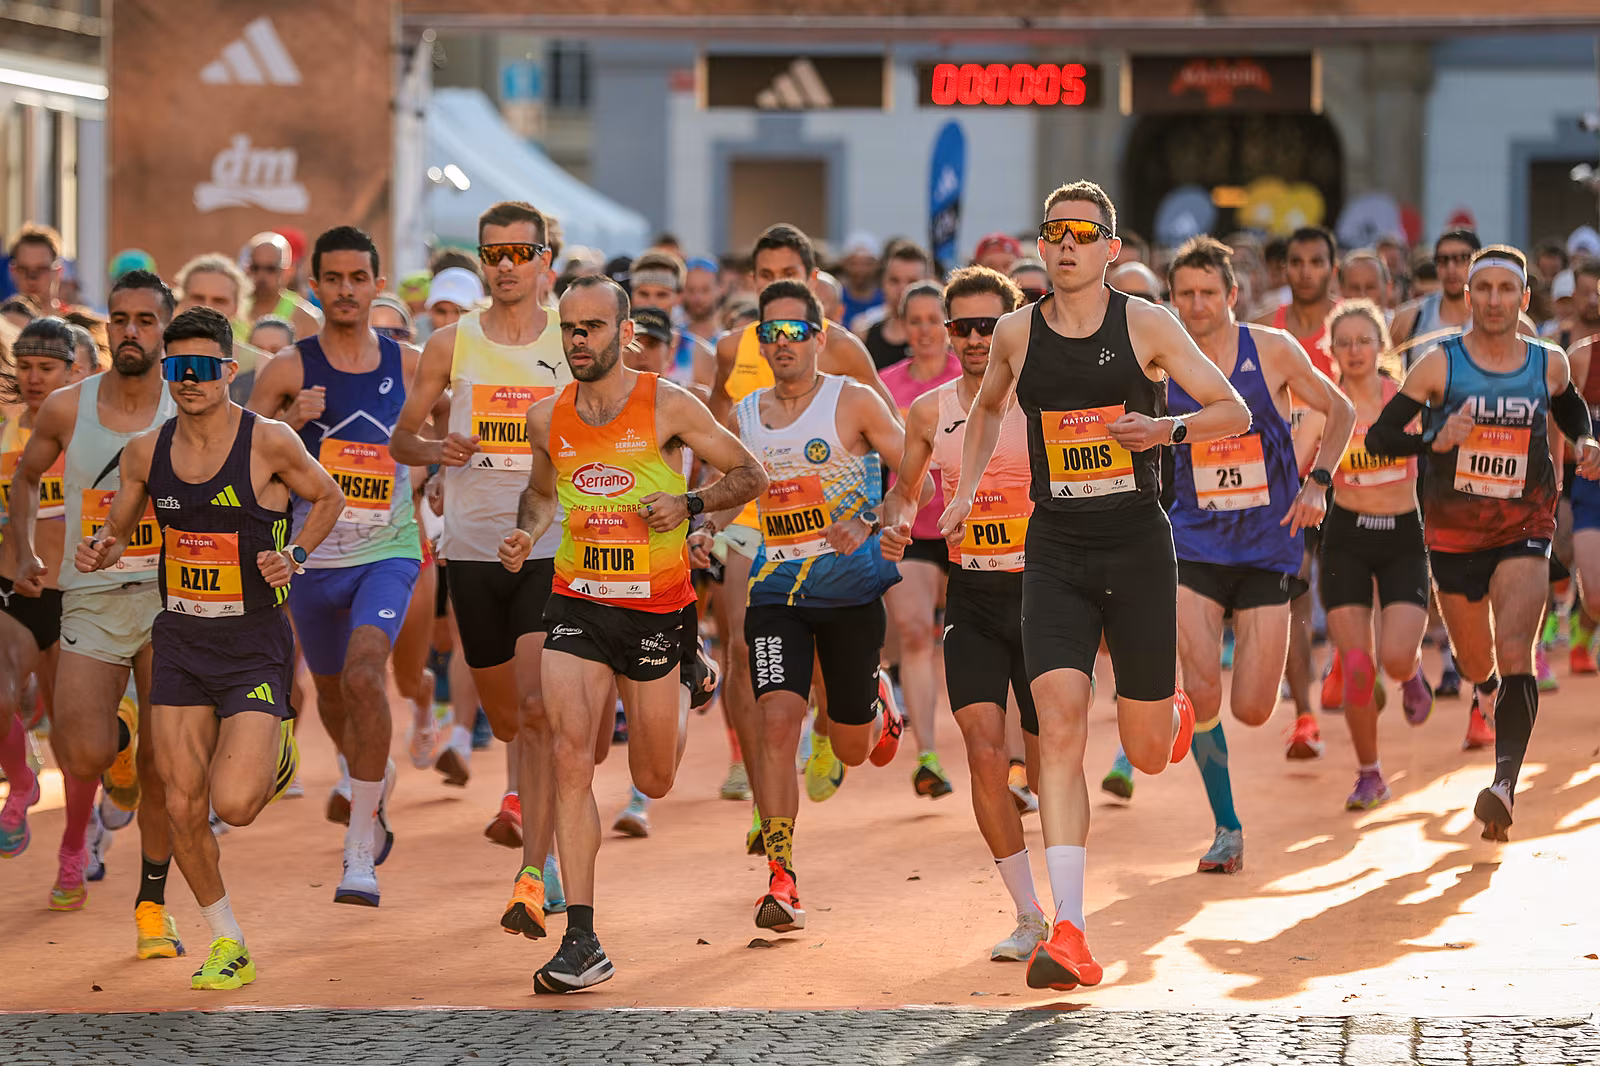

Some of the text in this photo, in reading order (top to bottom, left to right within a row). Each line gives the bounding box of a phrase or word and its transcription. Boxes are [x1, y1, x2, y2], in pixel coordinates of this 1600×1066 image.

[211, 133, 298, 189] dm
[495, 392, 532, 400] MATTONI
[1063, 415, 1099, 424] MATTONI
[615, 440, 647, 449] SERRANO
[1062, 444, 1112, 471] JORIS
[1468, 454, 1517, 477] 1060
[577, 474, 629, 488] Serrano
[1216, 467, 1243, 489] 25
[975, 495, 1003, 503] ATTONI
[766, 508, 825, 537] AMADEO
[180, 538, 213, 546] MATTONI
[972, 523, 1011, 545] POL
[583, 546, 635, 571] ARTUR
[181, 566, 221, 591] AZIZ
[767, 636, 785, 684] SURCO
